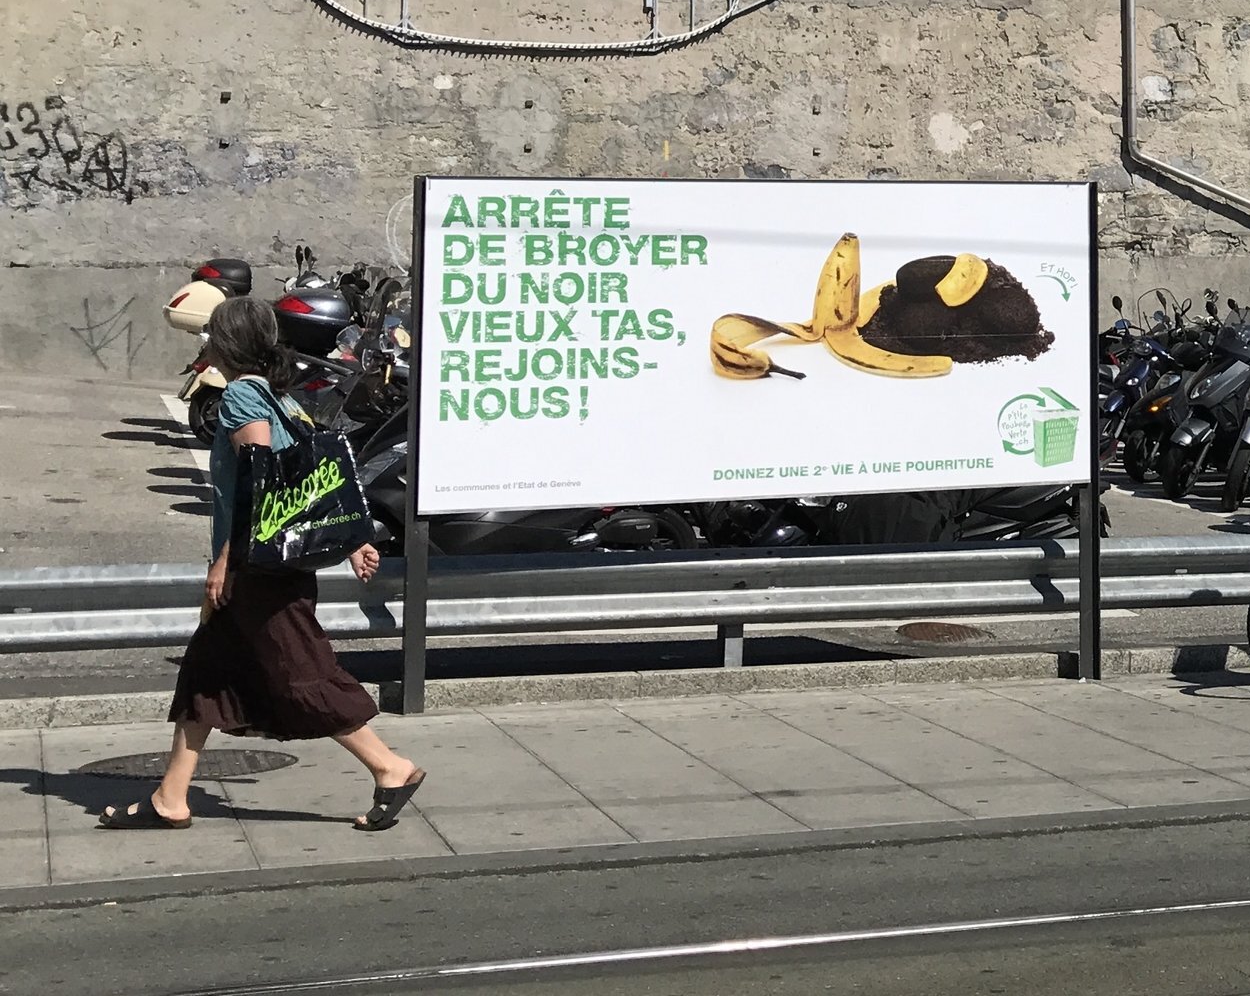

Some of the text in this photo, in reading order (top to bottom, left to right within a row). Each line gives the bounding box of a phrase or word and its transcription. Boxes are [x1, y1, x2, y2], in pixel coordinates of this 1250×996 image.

[441, 189, 630, 230] ARRÊTE
[442, 231, 708, 267] DE BROYER
[1040, 262, 1055, 273] ET
[441, 271, 629, 306] DU NOIR
[439, 308, 687, 346] VIEUX TAS,
[440, 347, 658, 384] REJOINS-
[713, 467, 774, 481] DONNEZ
[779, 466, 809, 478] UNE
[831, 462, 854, 475] VIE
[858, 461, 869, 474] À
[872, 462, 901, 473] UNE
[905, 457, 994, 471] POURRITURE
[259, 457, 341, 539] Chicorée
